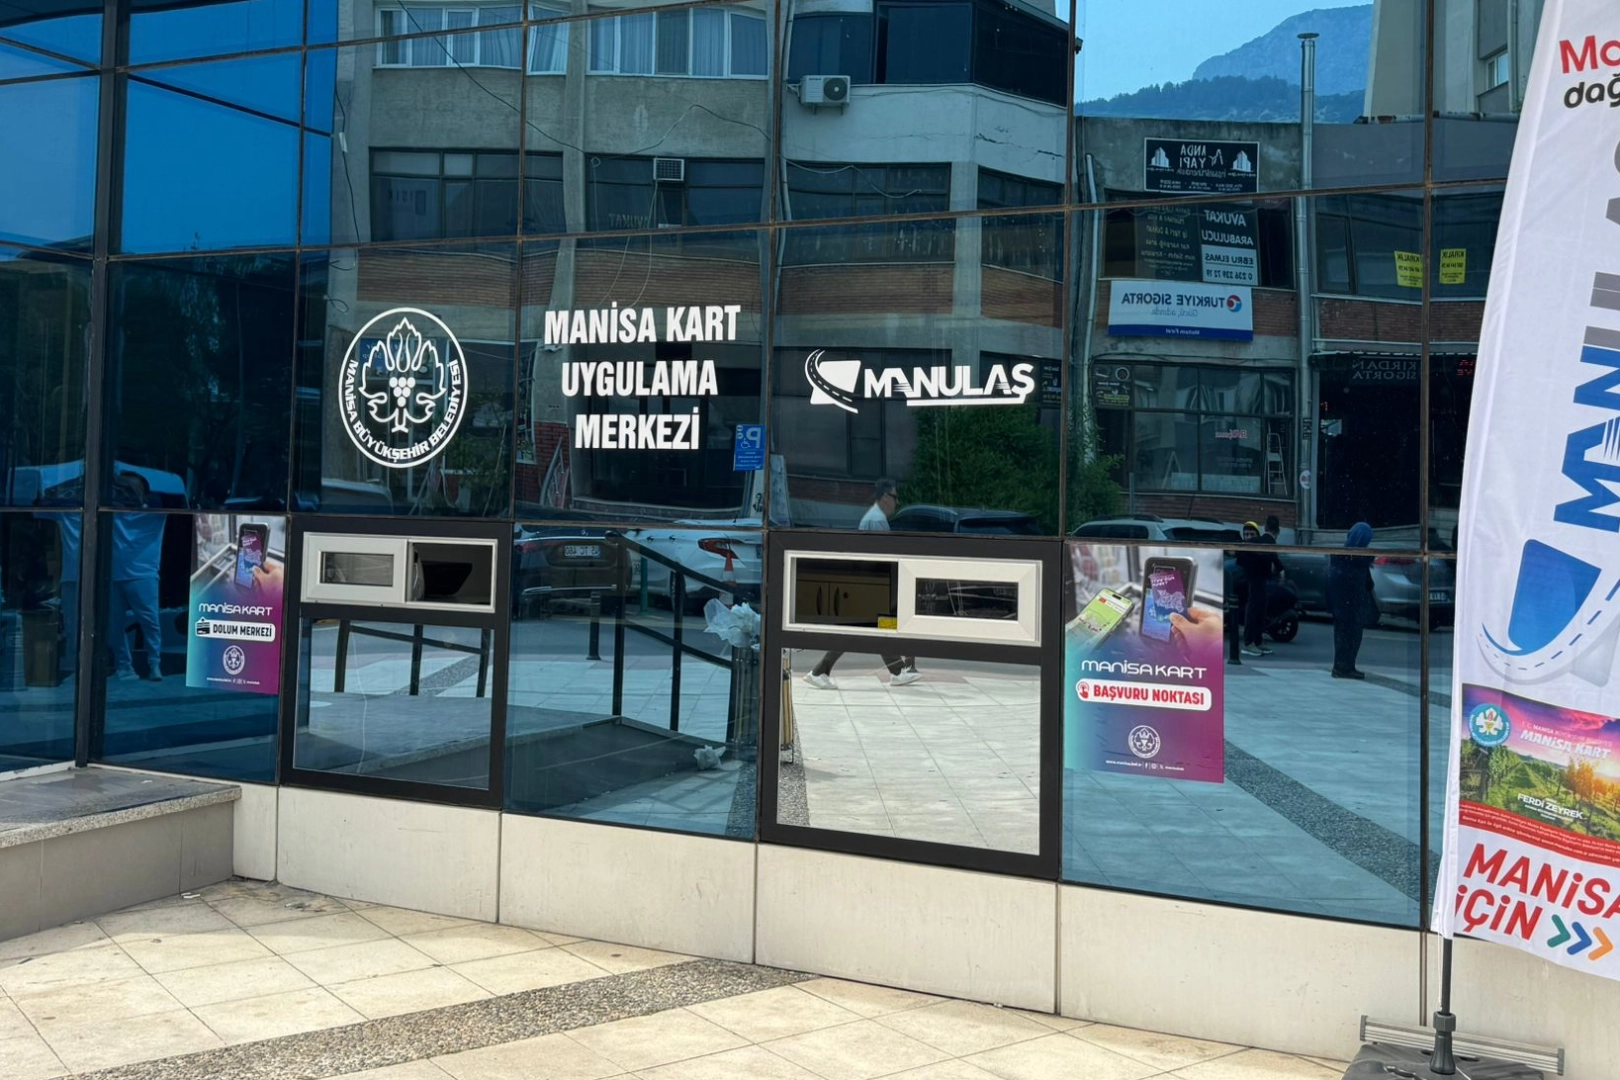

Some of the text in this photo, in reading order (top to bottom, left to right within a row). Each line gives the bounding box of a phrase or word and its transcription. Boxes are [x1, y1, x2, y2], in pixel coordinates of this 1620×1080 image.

[544, 300, 742, 346] MANİSA KART
[561, 359, 718, 397] UYGULAMA
[344, 359, 462, 464] MANİSA BÜYÜKŞEHİR BELEDİYESİ
[575, 405, 701, 450] MERKEZİ
[242, 606, 273, 617] KART
[213, 623, 272, 637] DOLUM MERKEZİ
[1155, 665, 1207, 680] KART
[1093, 684, 1205, 705] BAŞVURU NOKTASI
[1520, 730, 1612, 759] MANİSA KART
[1517, 793, 1545, 808] FERDİ
[1545, 799, 1583, 819] ZEYREK
[1455, 884, 1543, 942] İÇİN
